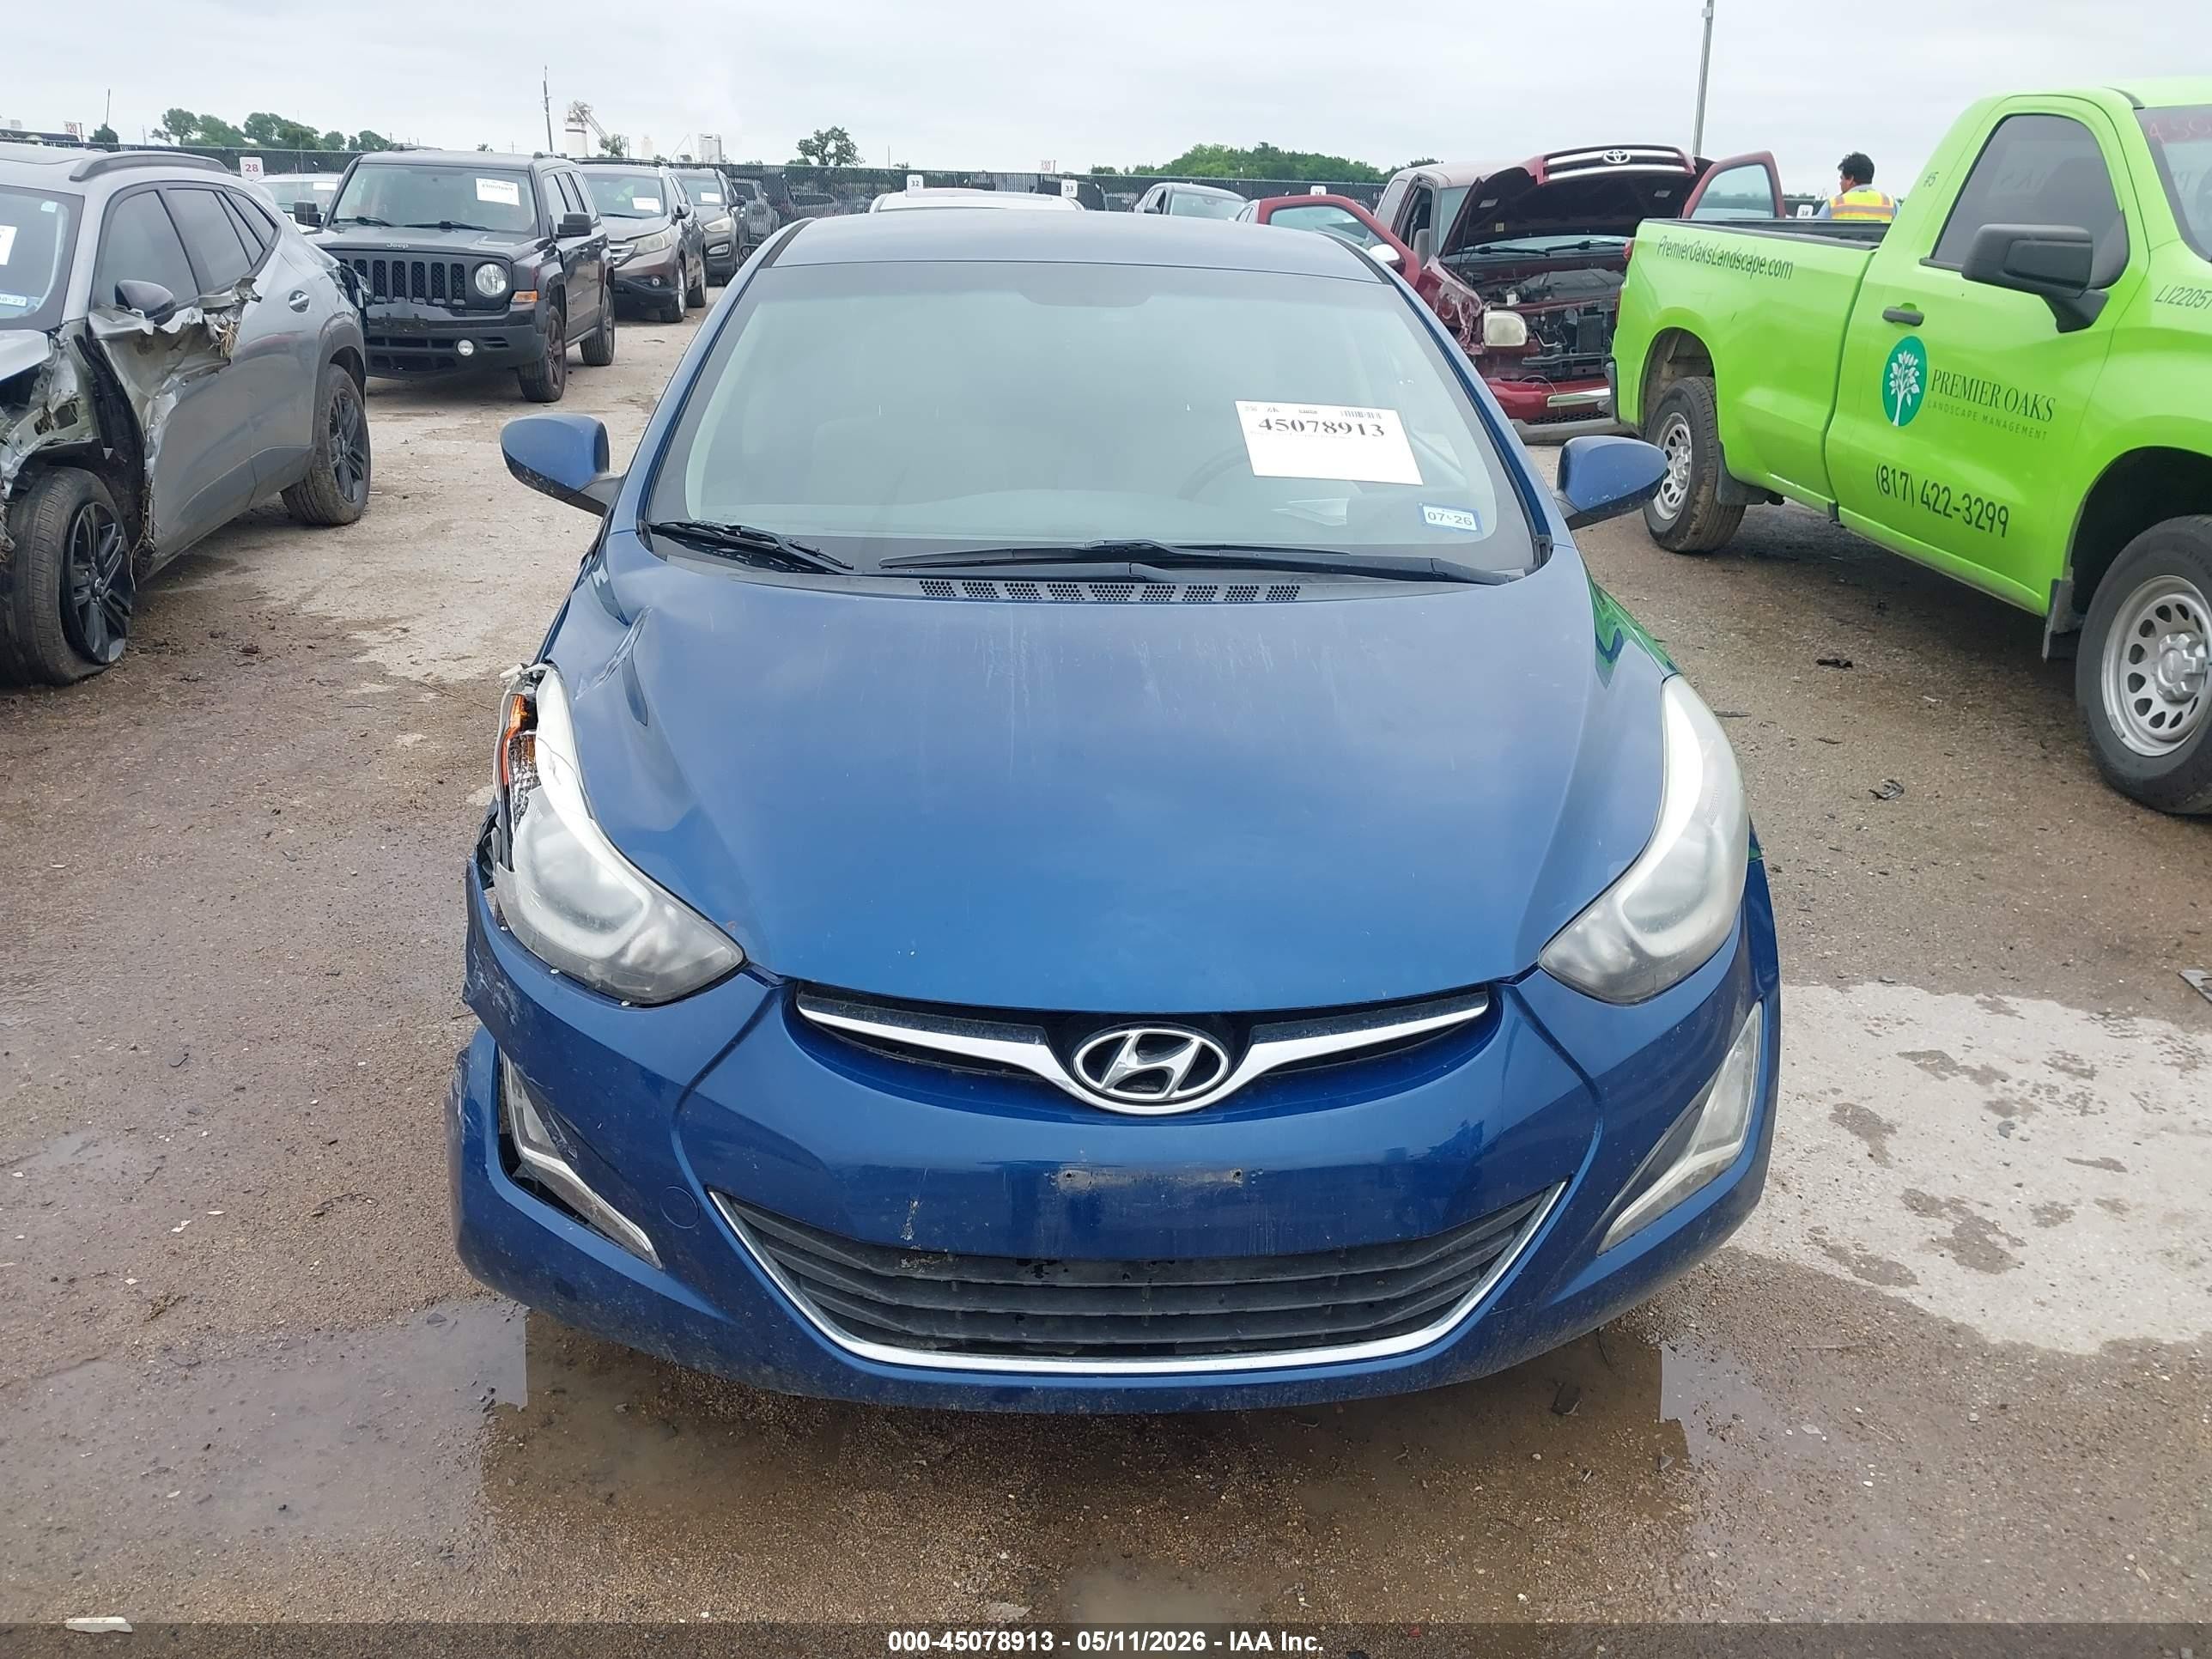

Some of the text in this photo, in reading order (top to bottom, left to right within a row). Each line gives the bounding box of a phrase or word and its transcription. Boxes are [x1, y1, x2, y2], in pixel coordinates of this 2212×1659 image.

[245, 163, 258, 172] 28
[1656, 234, 1794, 281] PremierOaksLandscape.com
[1930, 368, 2056, 422] PREMIER OAKS
[1258, 418, 1385, 437] 45078913
[1927, 398, 2048, 441] LANDSCAPE MANAGEMENT
[1875, 463, 2009, 538] (817) 422-3299
